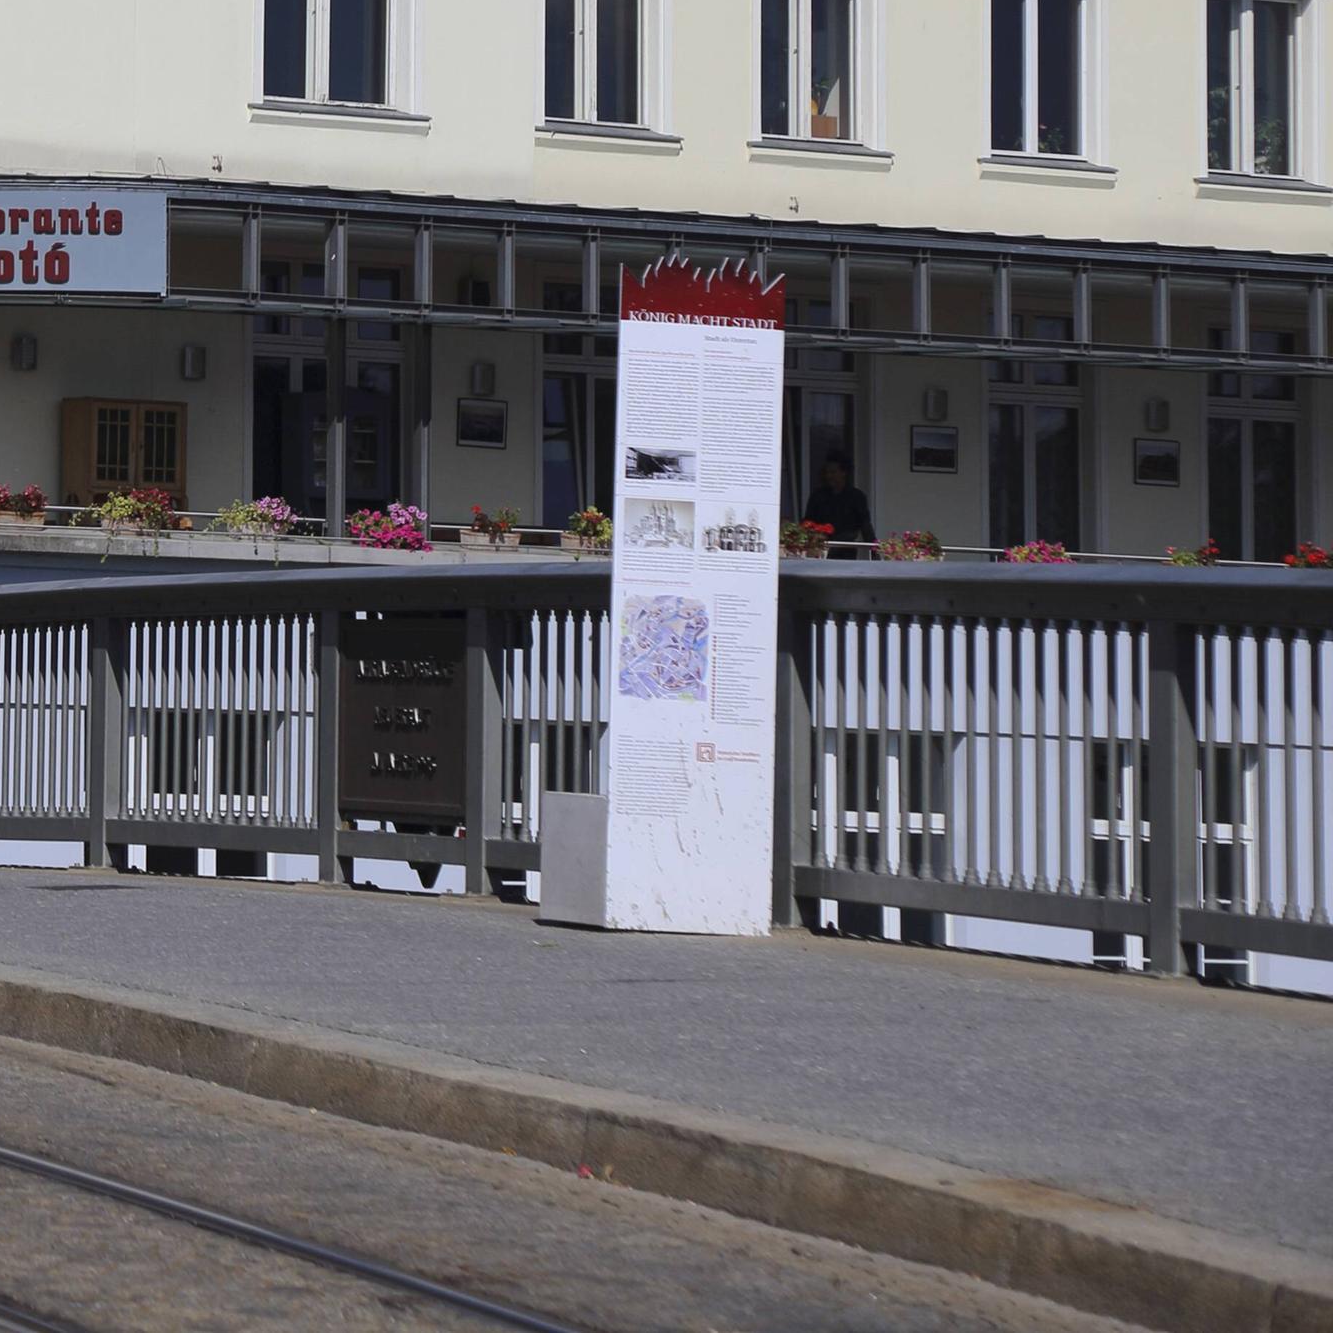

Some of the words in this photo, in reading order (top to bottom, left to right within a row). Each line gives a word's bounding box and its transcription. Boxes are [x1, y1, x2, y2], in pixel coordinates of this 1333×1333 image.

[629, 308, 675, 323] KÖNIG
[679, 313, 731, 327] MACHT
[732, 318, 778, 330] STADT
